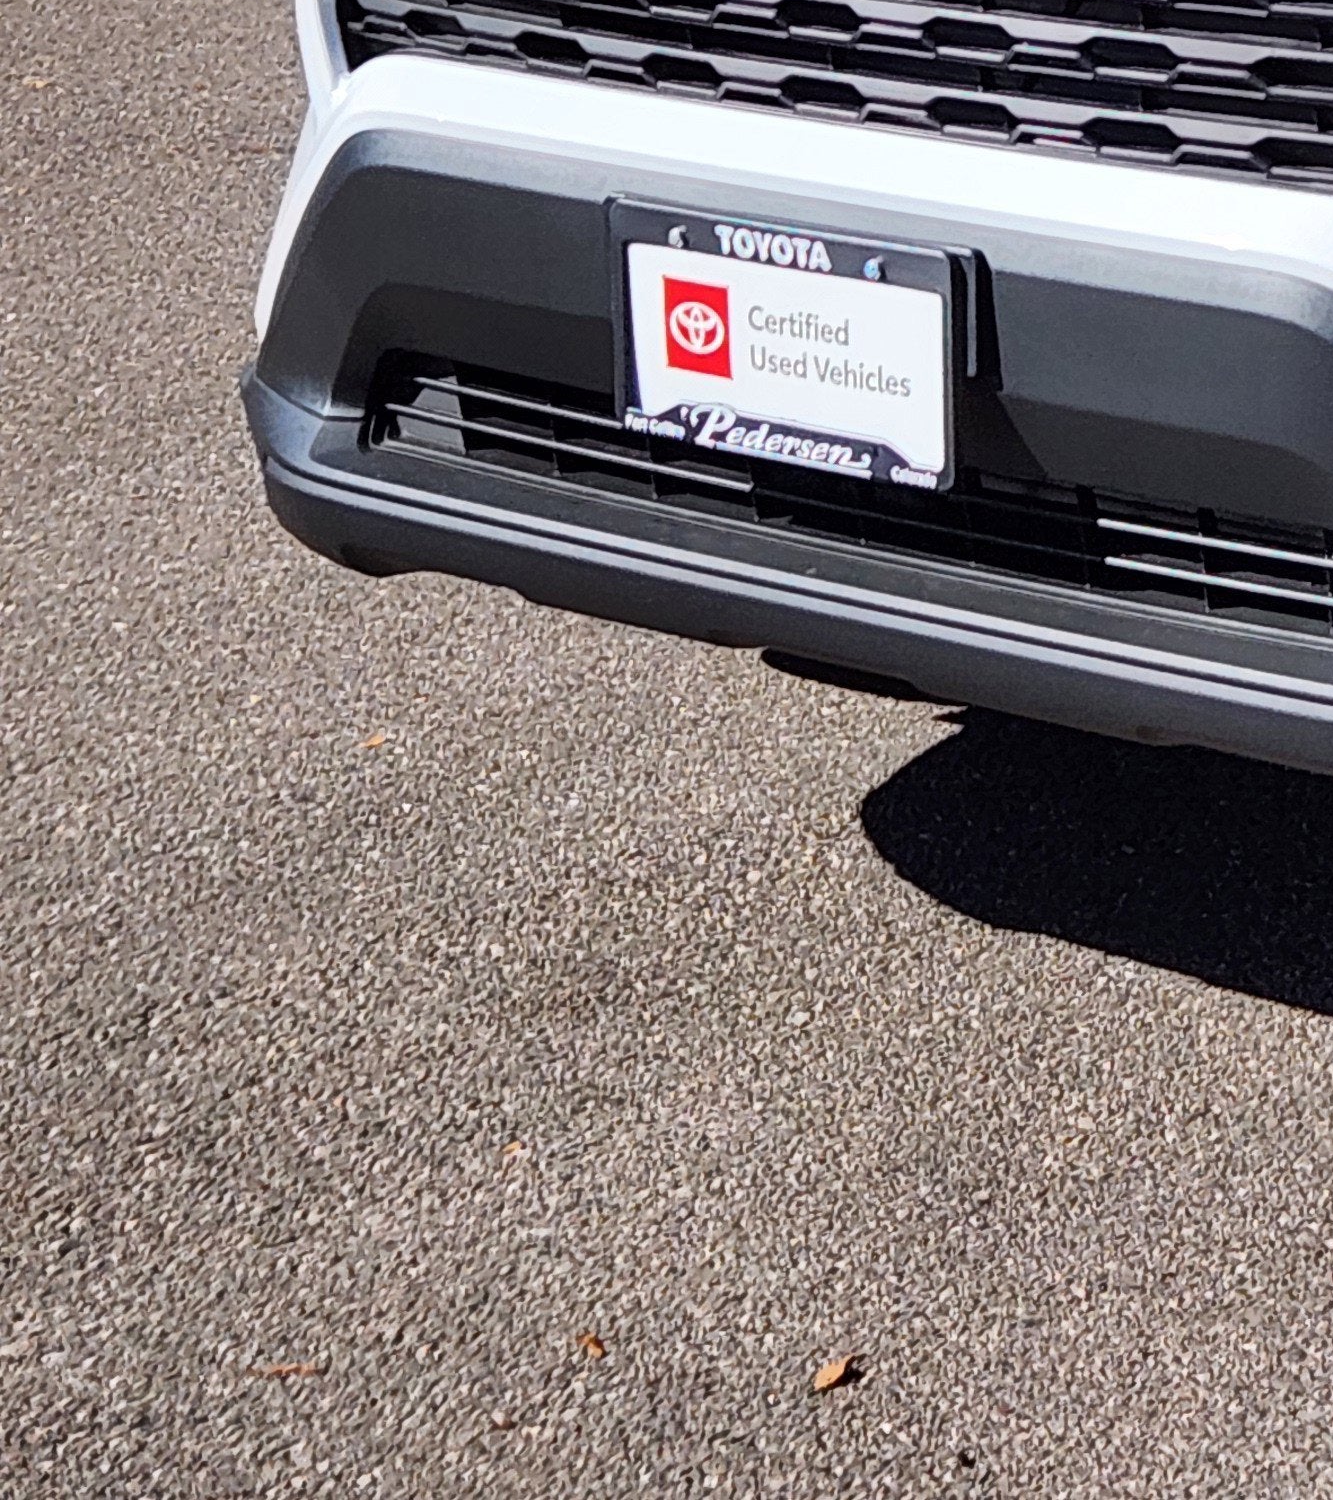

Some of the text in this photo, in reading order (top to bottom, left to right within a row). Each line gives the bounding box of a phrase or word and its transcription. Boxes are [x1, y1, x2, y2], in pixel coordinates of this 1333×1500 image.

[713, 223, 833, 273] TOYOTA
[747, 305, 851, 346] Certified
[750, 344, 912, 398] Used Vehicles
[689, 402, 872, 469] Pedersen
